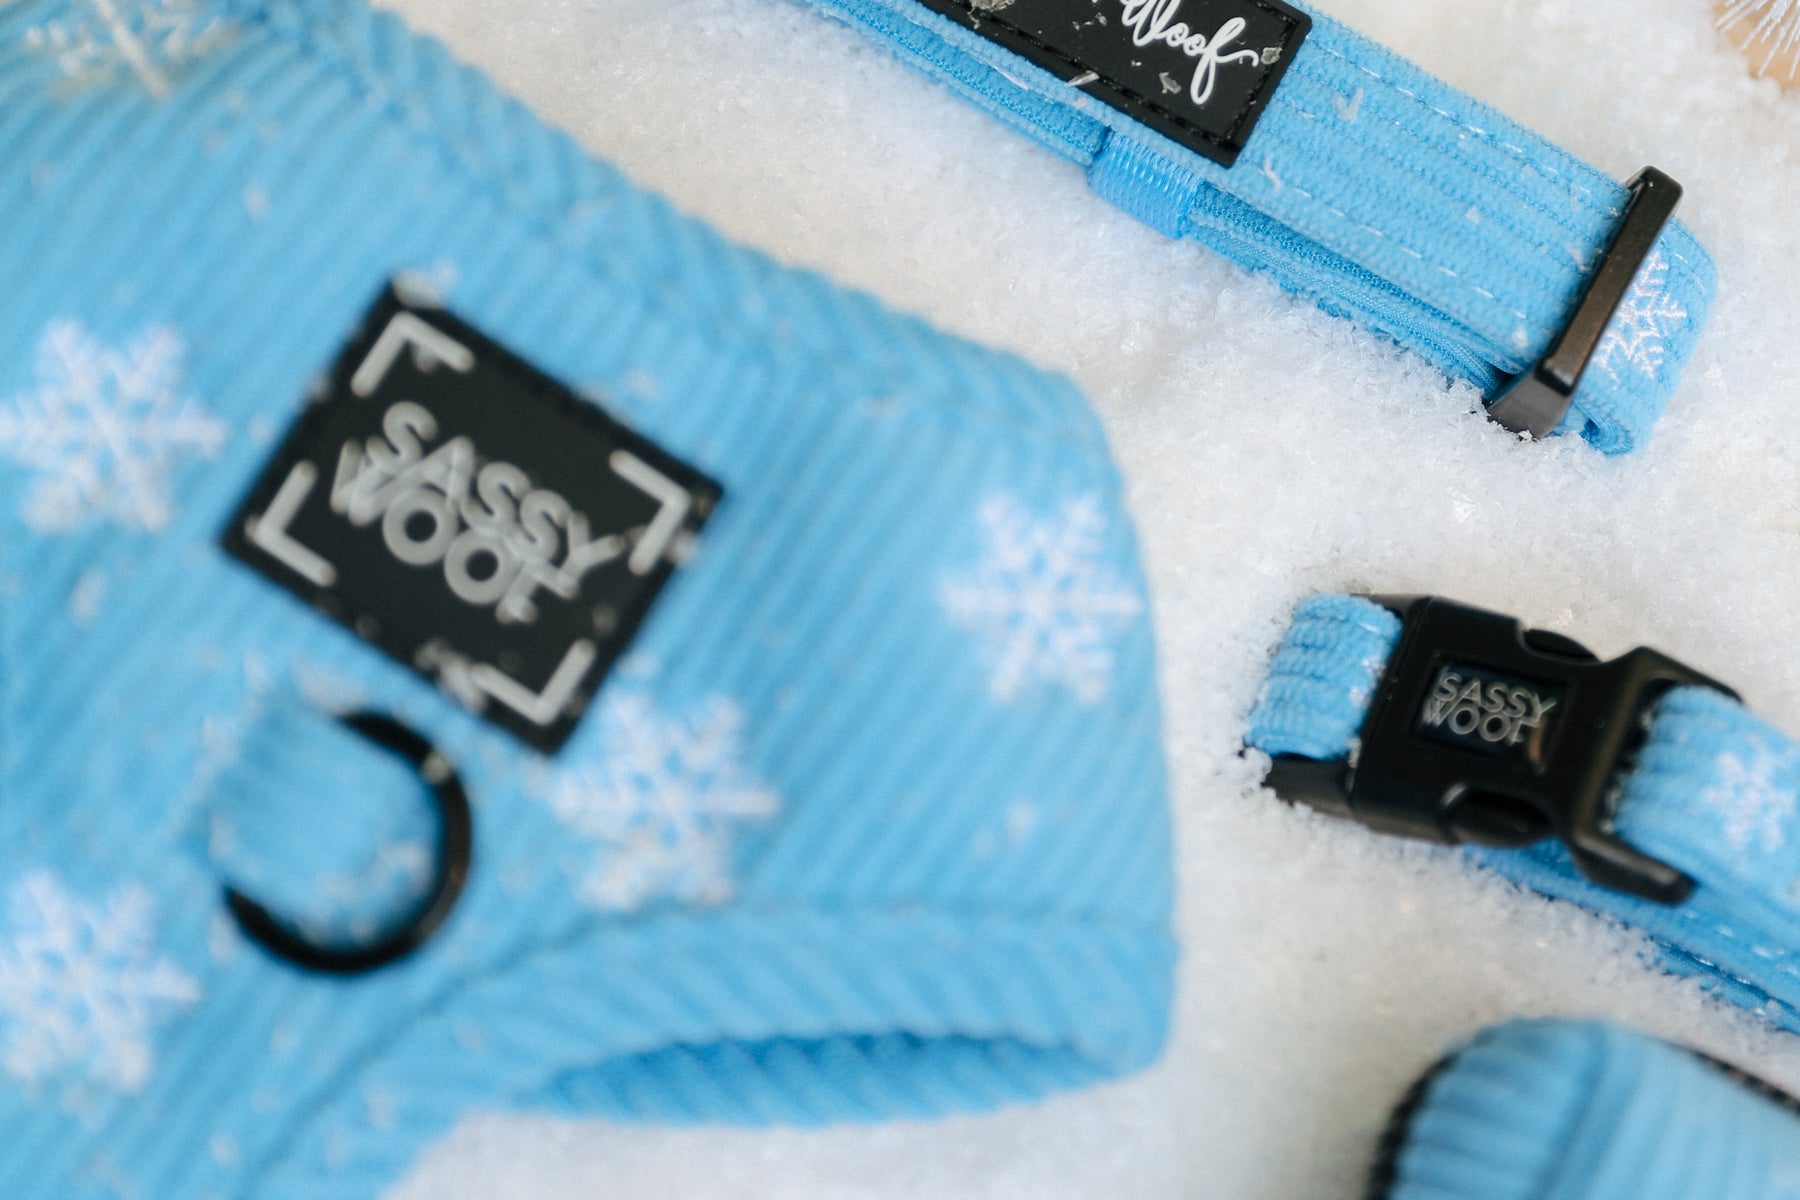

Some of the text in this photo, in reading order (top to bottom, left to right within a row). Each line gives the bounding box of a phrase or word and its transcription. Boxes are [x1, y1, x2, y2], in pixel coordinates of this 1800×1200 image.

[330, 438, 580, 623] WOOF
[364, 400, 625, 597] SASSY
[1421, 695, 1541, 746] WOOF
[1433, 672, 1558, 723] SASSY
